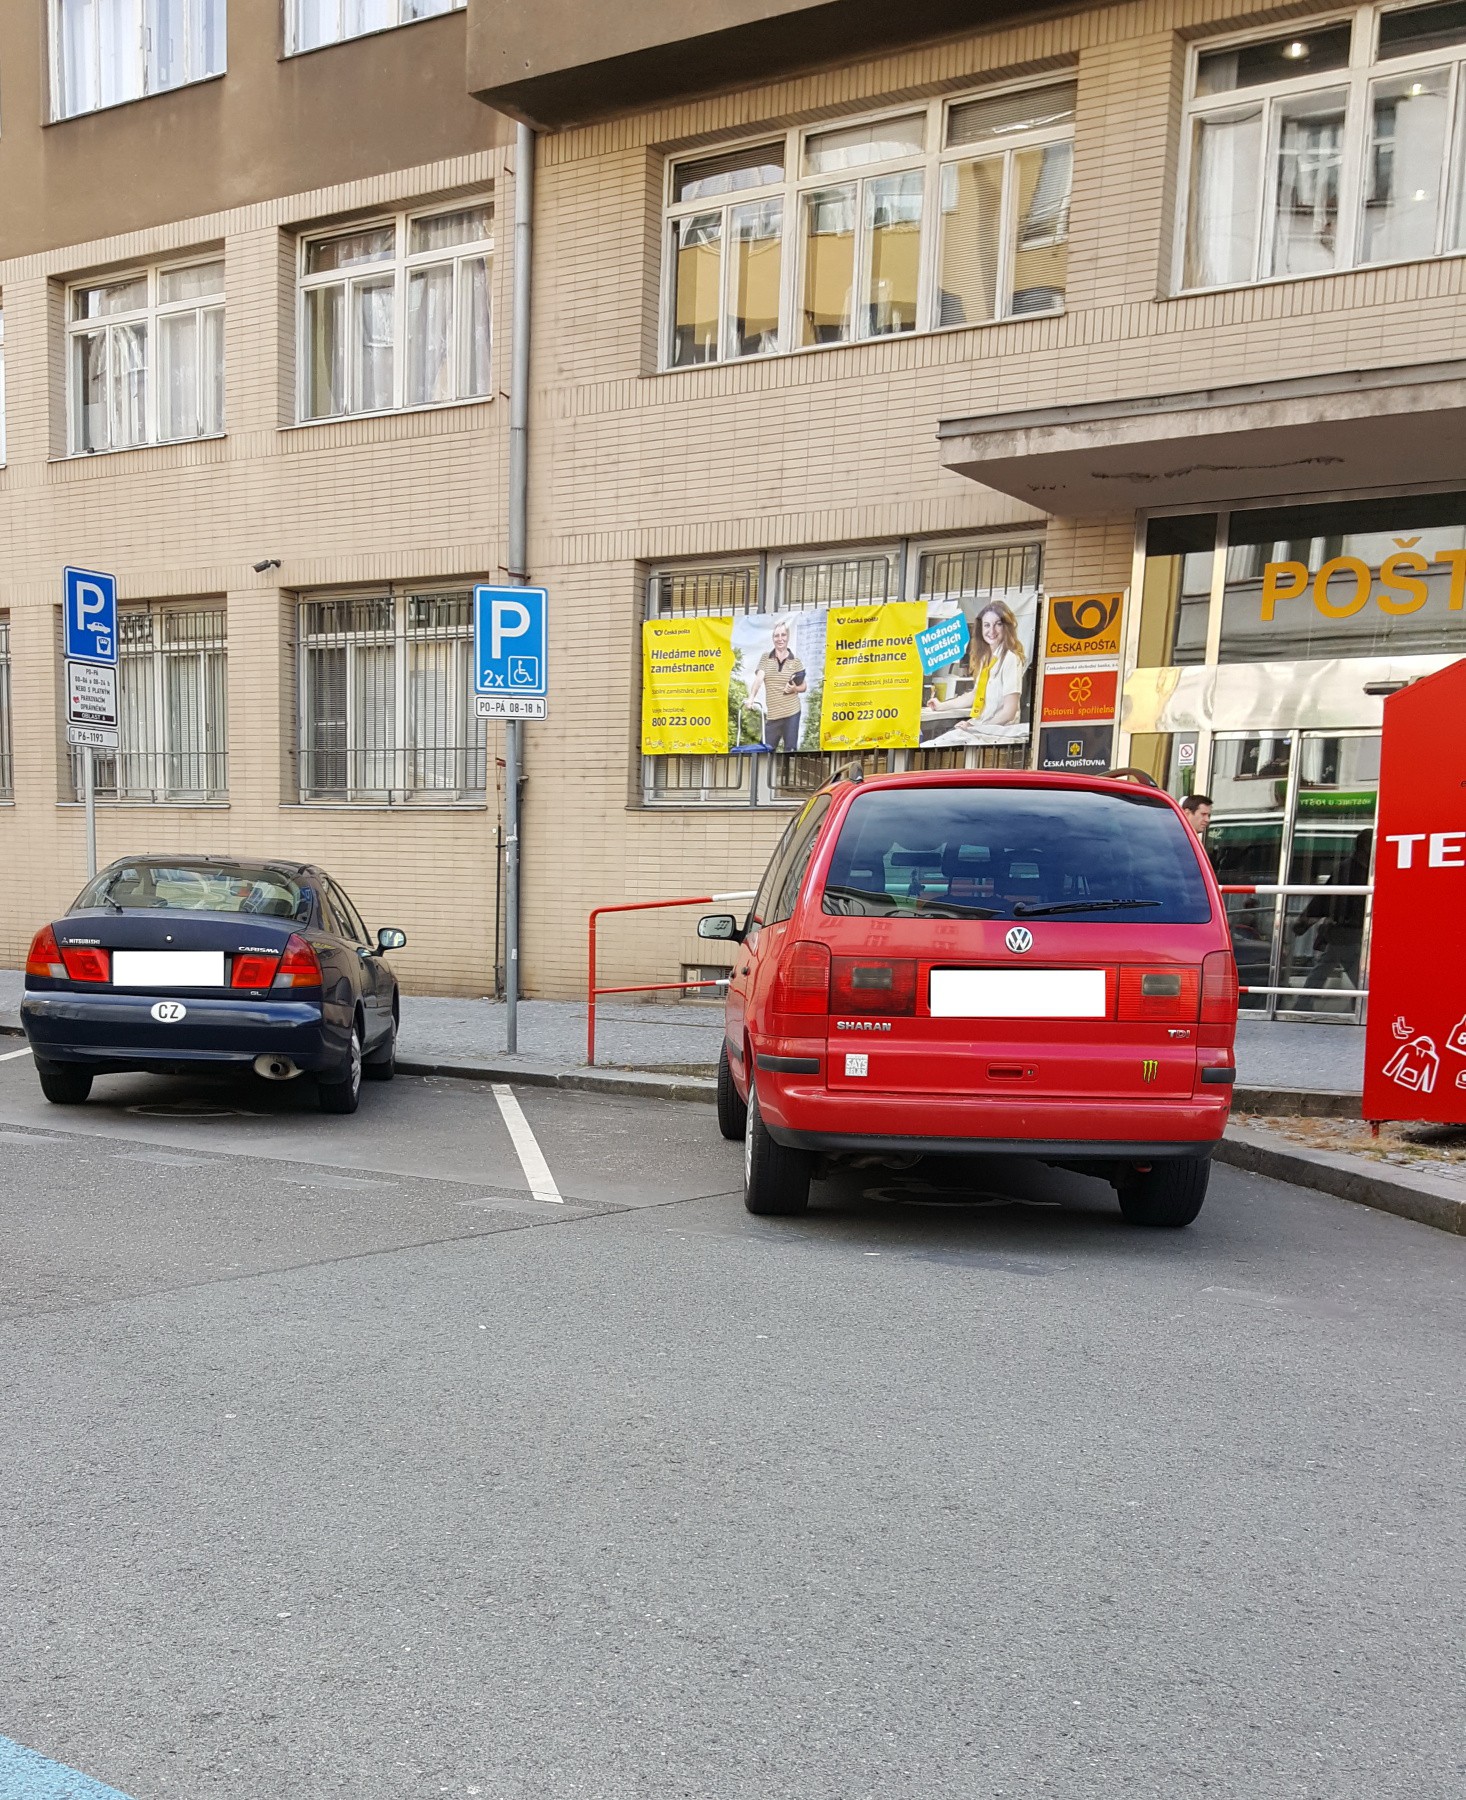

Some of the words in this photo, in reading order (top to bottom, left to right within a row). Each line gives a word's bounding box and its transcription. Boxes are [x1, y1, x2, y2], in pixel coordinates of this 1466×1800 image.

[76, 580, 105, 630] P
[491, 600, 531, 659] P
[920, 620, 961, 644] Možnost
[836, 638, 884, 650] Hledáme
[886, 634, 914, 646] nové
[924, 633, 961, 656] kratších
[1050, 641, 1082, 653] ČESKÁ
[1084, 639, 1117, 651] POŠTA
[651, 648, 696, 660] Hledáme
[698, 647, 722, 658] nové
[836, 652, 907, 666] zaměstnance
[928, 644, 960, 667] úvazků
[650, 663, 715, 674] zaměstnance
[483, 670, 504, 687] 2x
[480, 700, 505, 713] PO-PÁ
[509, 703, 533, 713] 08-18
[536, 704, 542, 713] h
[1043, 707, 1074, 716] Poštovní
[1078, 705, 1115, 716] spořitelna
[652, 717, 667, 726] 800
[669, 716, 687, 726] 223
[690, 716, 711, 726] 000
[832, 711, 854, 722] 800
[857, 710, 874, 720] 223
[876, 708, 899, 719] 000
[78, 731, 104, 743] P6-1193
[1043, 758, 1065, 768] ČESKÁ
[1065, 758, 1106, 768] POJIŠŤOVNA
[158, 1004, 179, 1019] CZ
[837, 1021, 892, 1031] SHARAN
[1167, 1029, 1191, 1038] TDI
